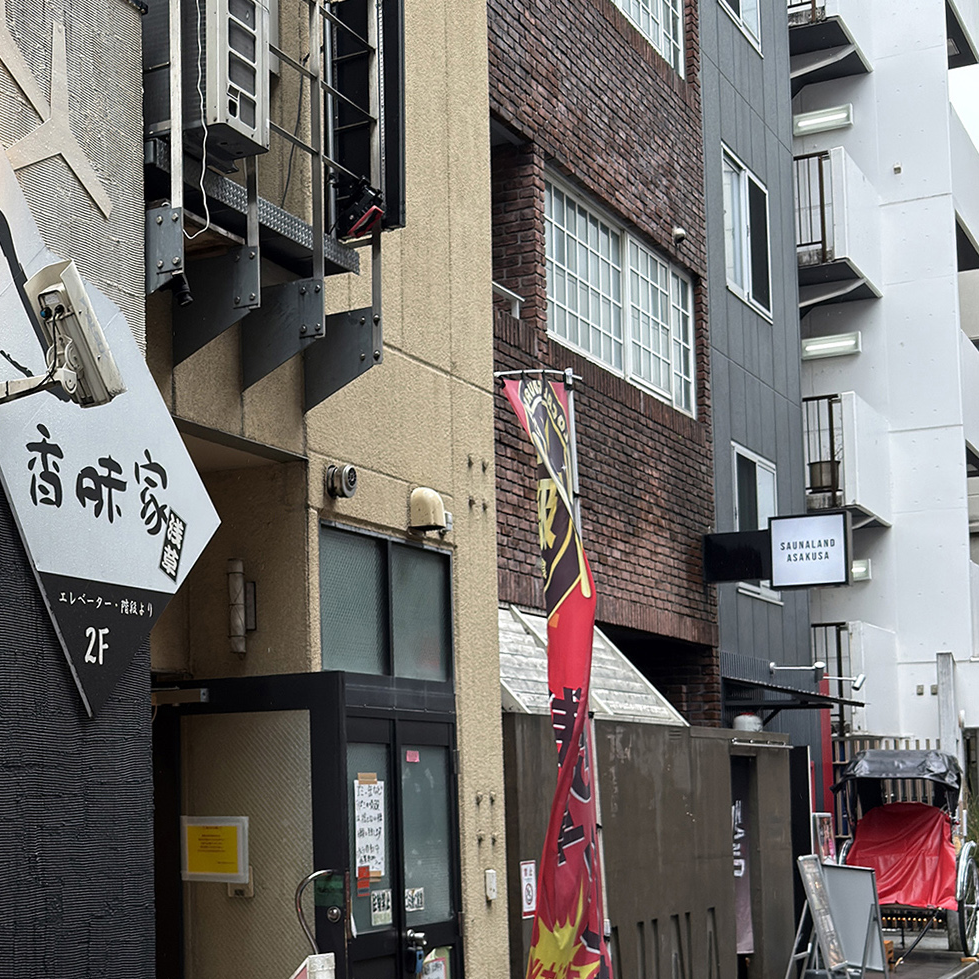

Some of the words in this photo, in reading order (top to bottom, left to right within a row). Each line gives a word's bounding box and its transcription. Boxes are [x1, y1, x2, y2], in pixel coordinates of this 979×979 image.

[26, 423, 168, 535] 香味家
[780, 538, 836, 551] SAUNALAND
[786, 551, 830, 563] ASAKUSA
[58, 591, 154, 617] エレベーター・階段より
[84, 626, 110, 665] 2F
